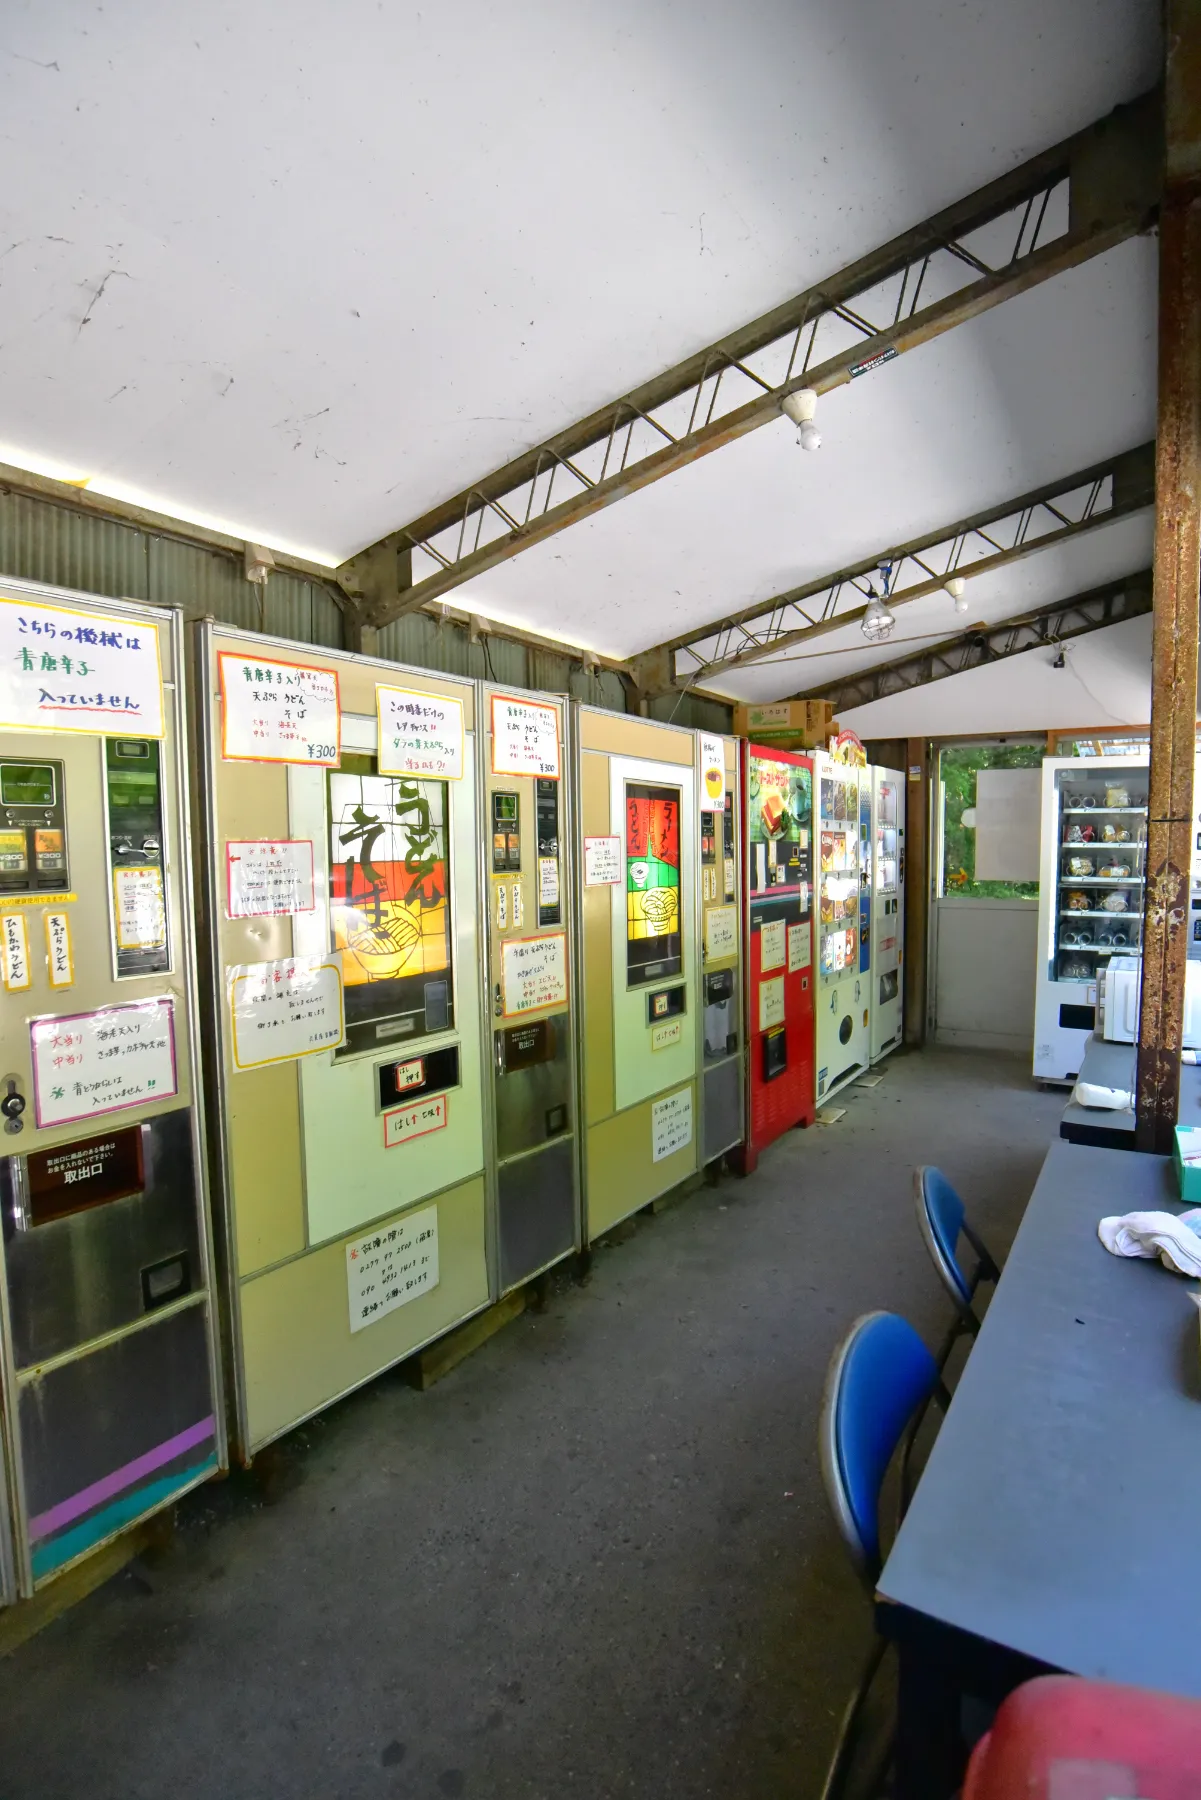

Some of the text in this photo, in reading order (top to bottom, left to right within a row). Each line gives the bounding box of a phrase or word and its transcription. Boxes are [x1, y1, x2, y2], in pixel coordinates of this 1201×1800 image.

[17, 617, 142, 650] こちらの機械は
[14, 647, 95, 676] 青唐辛子
[242, 666, 301, 687] 青唐辛子入り
[38, 688, 140, 709] 入っていません
[307, 743, 336, 758] ¥300
[540, 763, 555, 772] ¥300
[395, 783, 441, 907] うどん
[338, 804, 391, 940] そば
[6, 917, 24, 980] ひもかわうどん
[50, 917, 67, 973] 天ぷらうどん
[49, 1034, 83, 1049] 大当り
[52, 1054, 84, 1069] 中当り
[63, 1163, 103, 1185] 取出口
